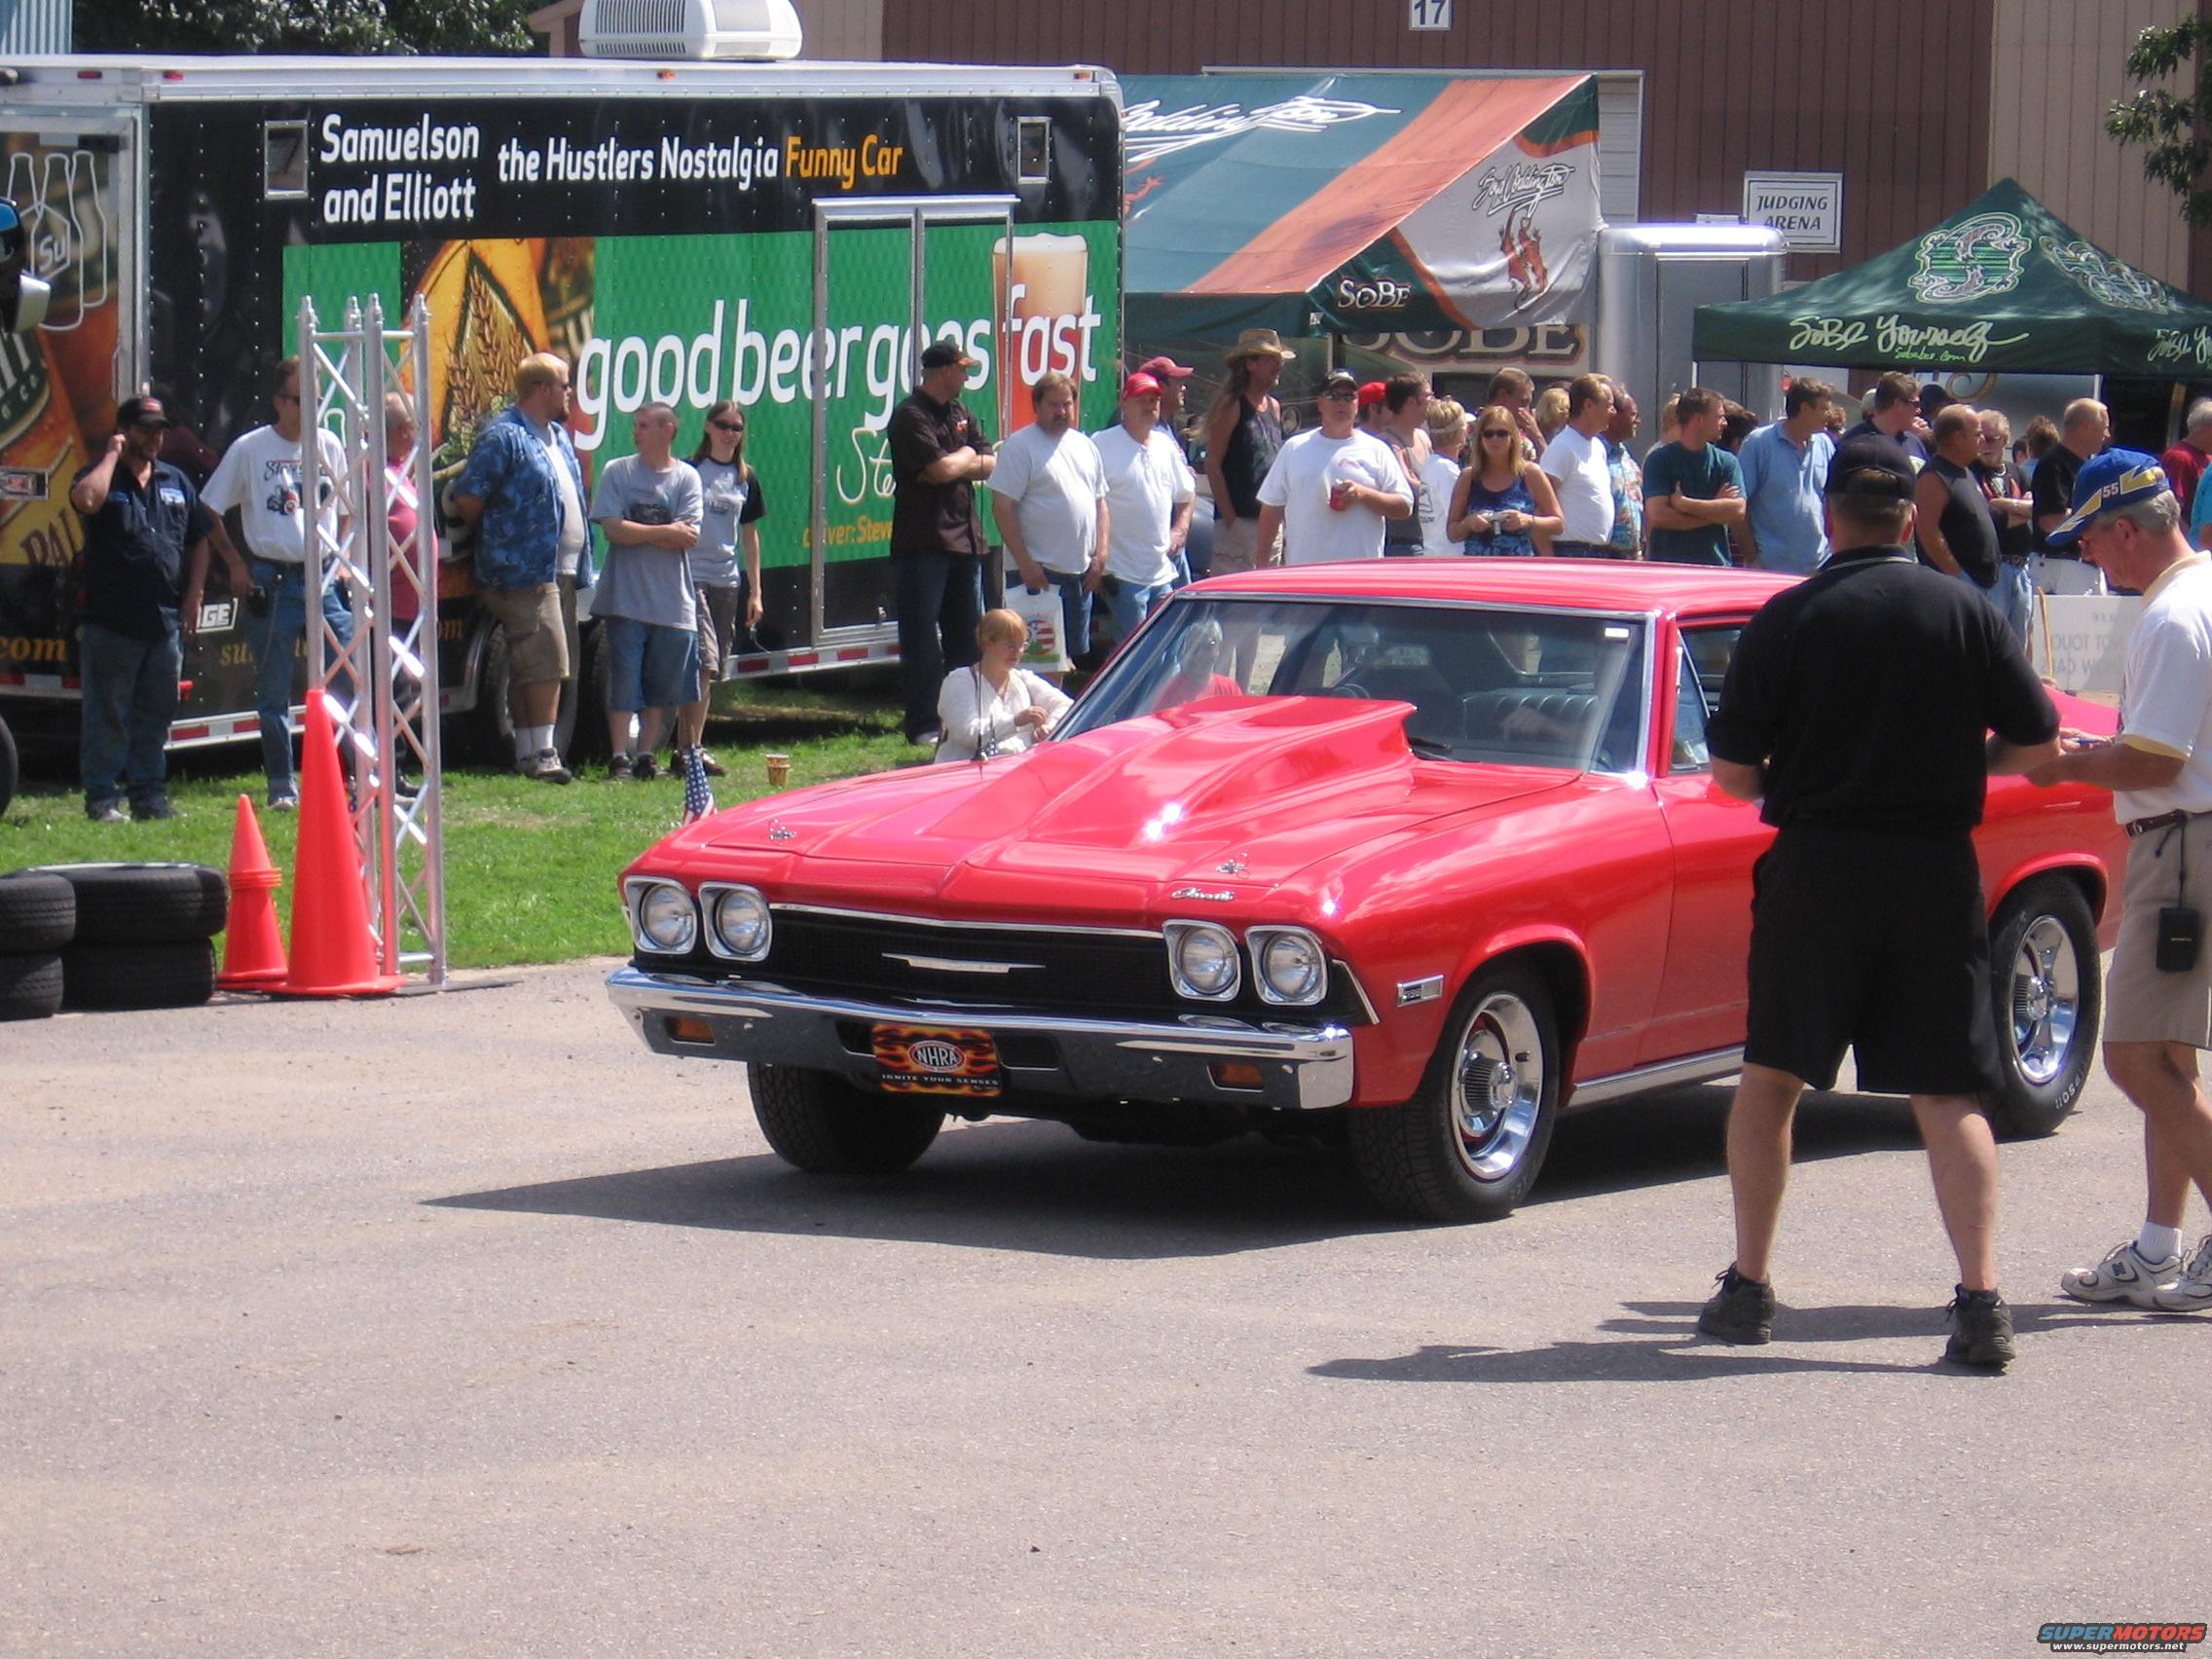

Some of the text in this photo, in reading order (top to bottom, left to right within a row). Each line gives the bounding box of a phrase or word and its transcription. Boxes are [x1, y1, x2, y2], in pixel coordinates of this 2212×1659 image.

[1414, 0, 1447, 25] 17
[320, 113, 480, 164] Samuelson
[498, 133, 903, 191] the Hustlers Nostalgia Funny Car
[323, 170, 477, 224] and Elliott
[1756, 195, 1828, 212] JUDGING
[1763, 215, 1821, 230] ARENA
[574, 299, 724, 452] good
[731, 298, 864, 407] beer
[2102, 482, 2120, 498] 55
[917, 1046, 957, 1065] NHRA
